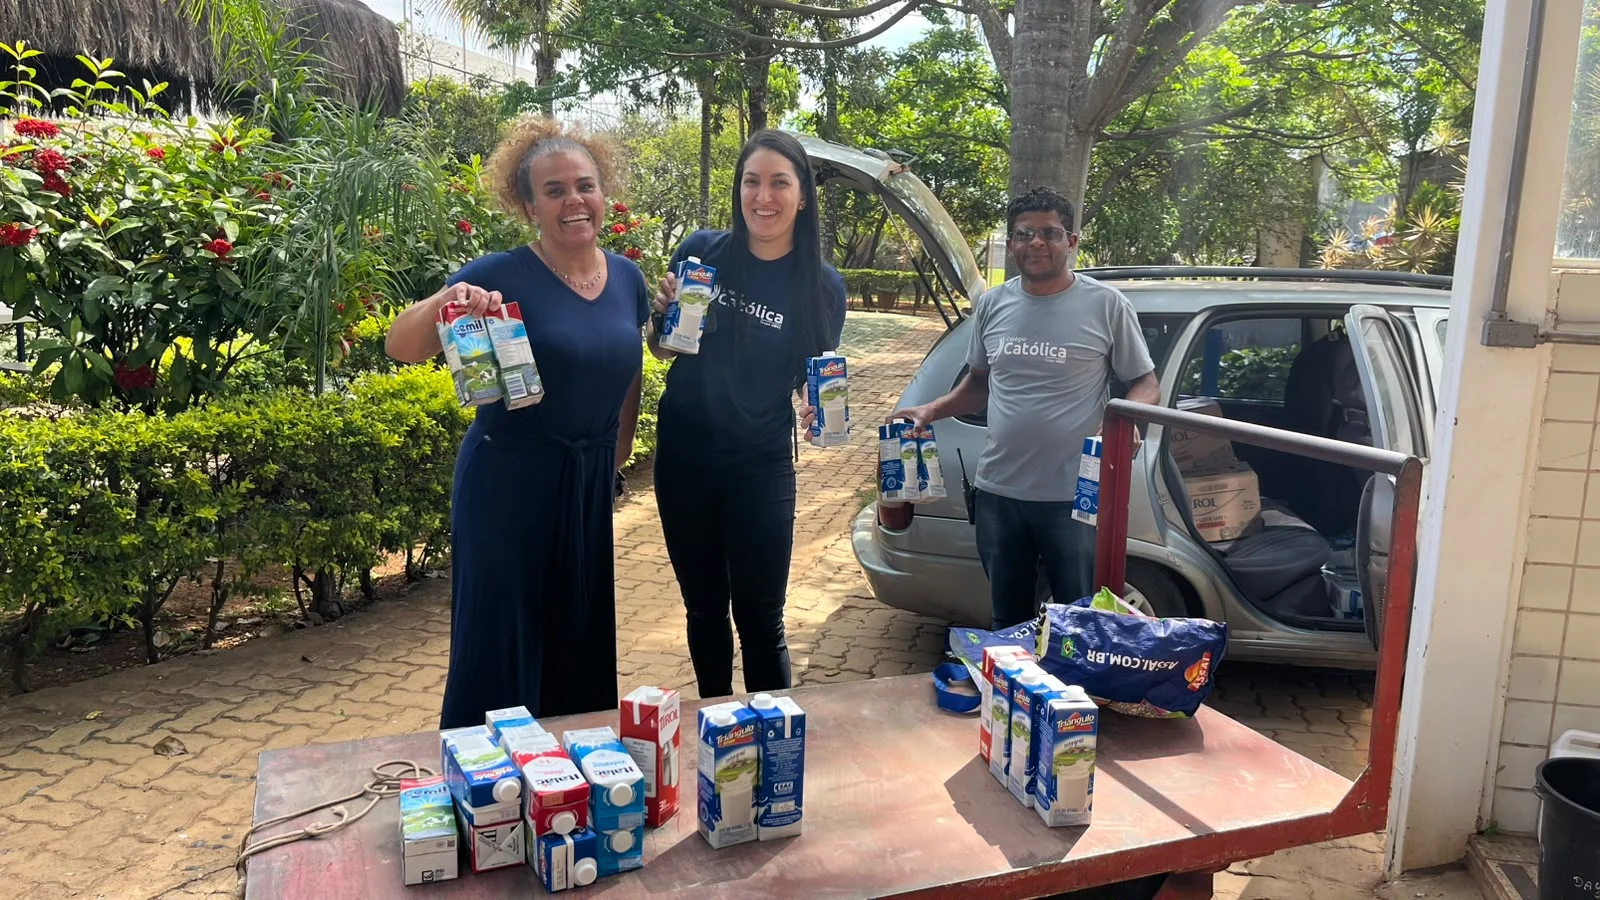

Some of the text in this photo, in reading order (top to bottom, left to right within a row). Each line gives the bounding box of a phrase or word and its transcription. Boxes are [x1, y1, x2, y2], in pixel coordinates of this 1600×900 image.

[453, 319, 483, 333] cemil
[1004, 341, 1067, 358] Católica
[1193, 498, 1218, 508] ROL
[660, 709, 679, 730] TIROL
